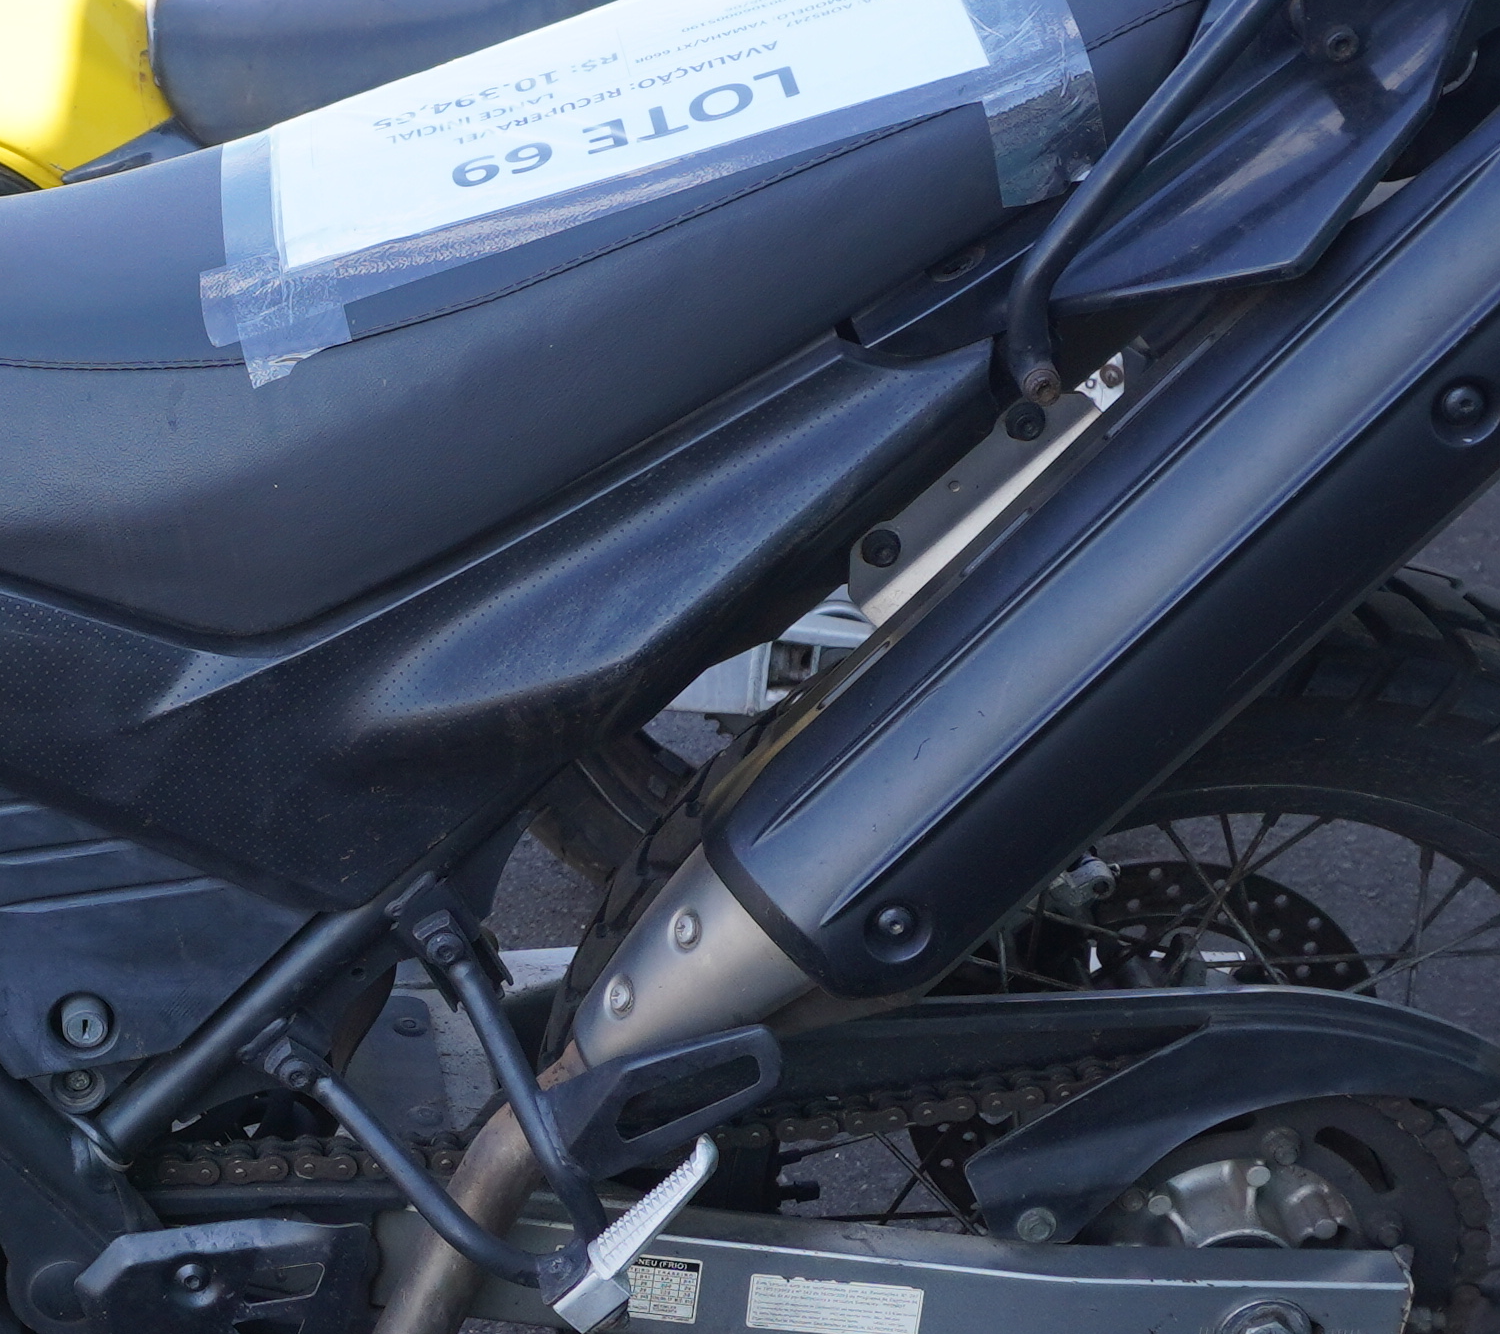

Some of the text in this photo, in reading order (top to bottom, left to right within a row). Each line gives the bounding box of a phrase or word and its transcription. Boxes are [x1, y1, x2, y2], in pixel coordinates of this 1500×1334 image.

[627, 39, 777, 92] AVALIAÇÃO:
[451, 65, 801, 188] LOTE 69
[635, 1257, 687, 1270] NEU (FRIO)
